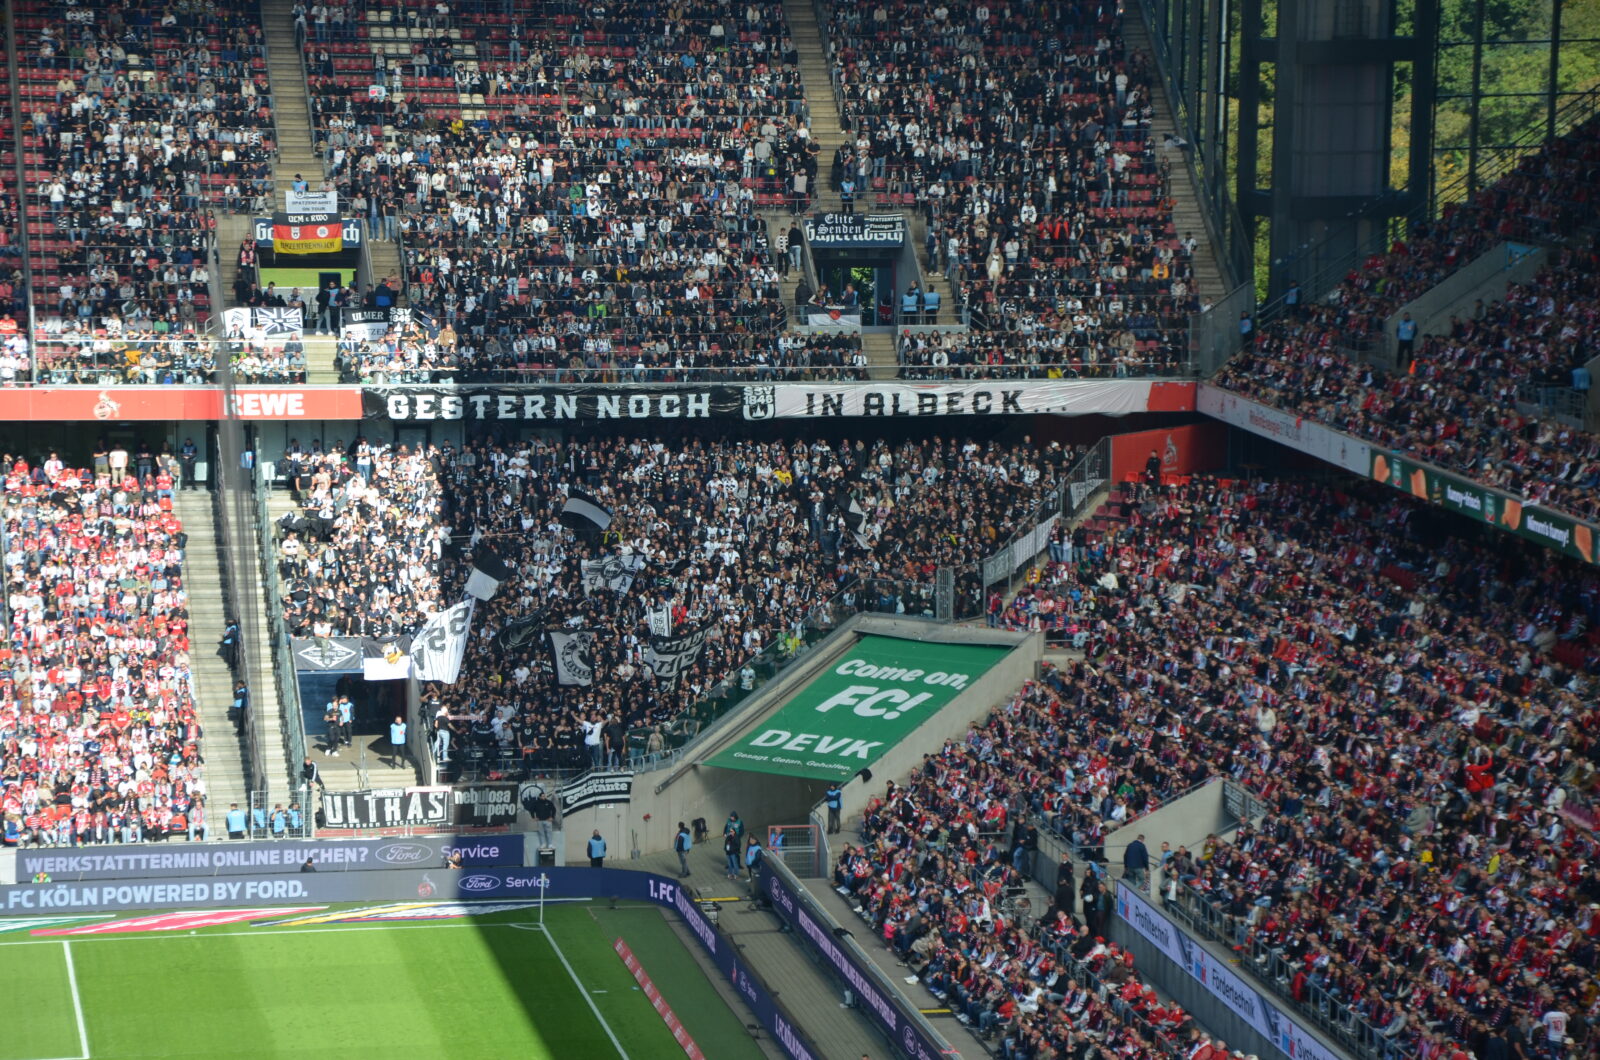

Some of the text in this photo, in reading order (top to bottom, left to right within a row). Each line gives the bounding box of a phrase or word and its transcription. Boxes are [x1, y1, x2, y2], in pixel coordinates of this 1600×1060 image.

[288, 215, 304, 223] ULM
[824, 213, 854, 224] Elite
[818, 224, 862, 235] Senden
[351, 311, 384, 322] ULMER
[388, 314, 411, 322] 1846
[389, 306, 412, 316] SSV
[743, 385, 774, 396] SSV
[224, 393, 304, 416] REWE
[387, 392, 711, 420] GESTERN NOCH
[743, 394, 774, 405] 1846
[805, 392, 844, 417] IN
[835, 659, 925, 682] Come
[815, 684, 933, 720] FC!
[749, 729, 884, 760] DEVK
[733, 751, 769, 762] Gesagt.
[772, 756, 803, 767] Getan.
[454, 789, 511, 804] nebulosa
[324, 790, 443, 824] ULTRAS
[473, 801, 516, 823] impero
[25, 846, 369, 874] WERKSTATTTERMIN ONLINE BUCHEN?
[386, 845, 422, 861] Ford
[466, 876, 493, 888] Ford
[8, 879, 308, 909] FC KÖLN POWERED BY FORD.
[659, 882, 674, 903] FC
